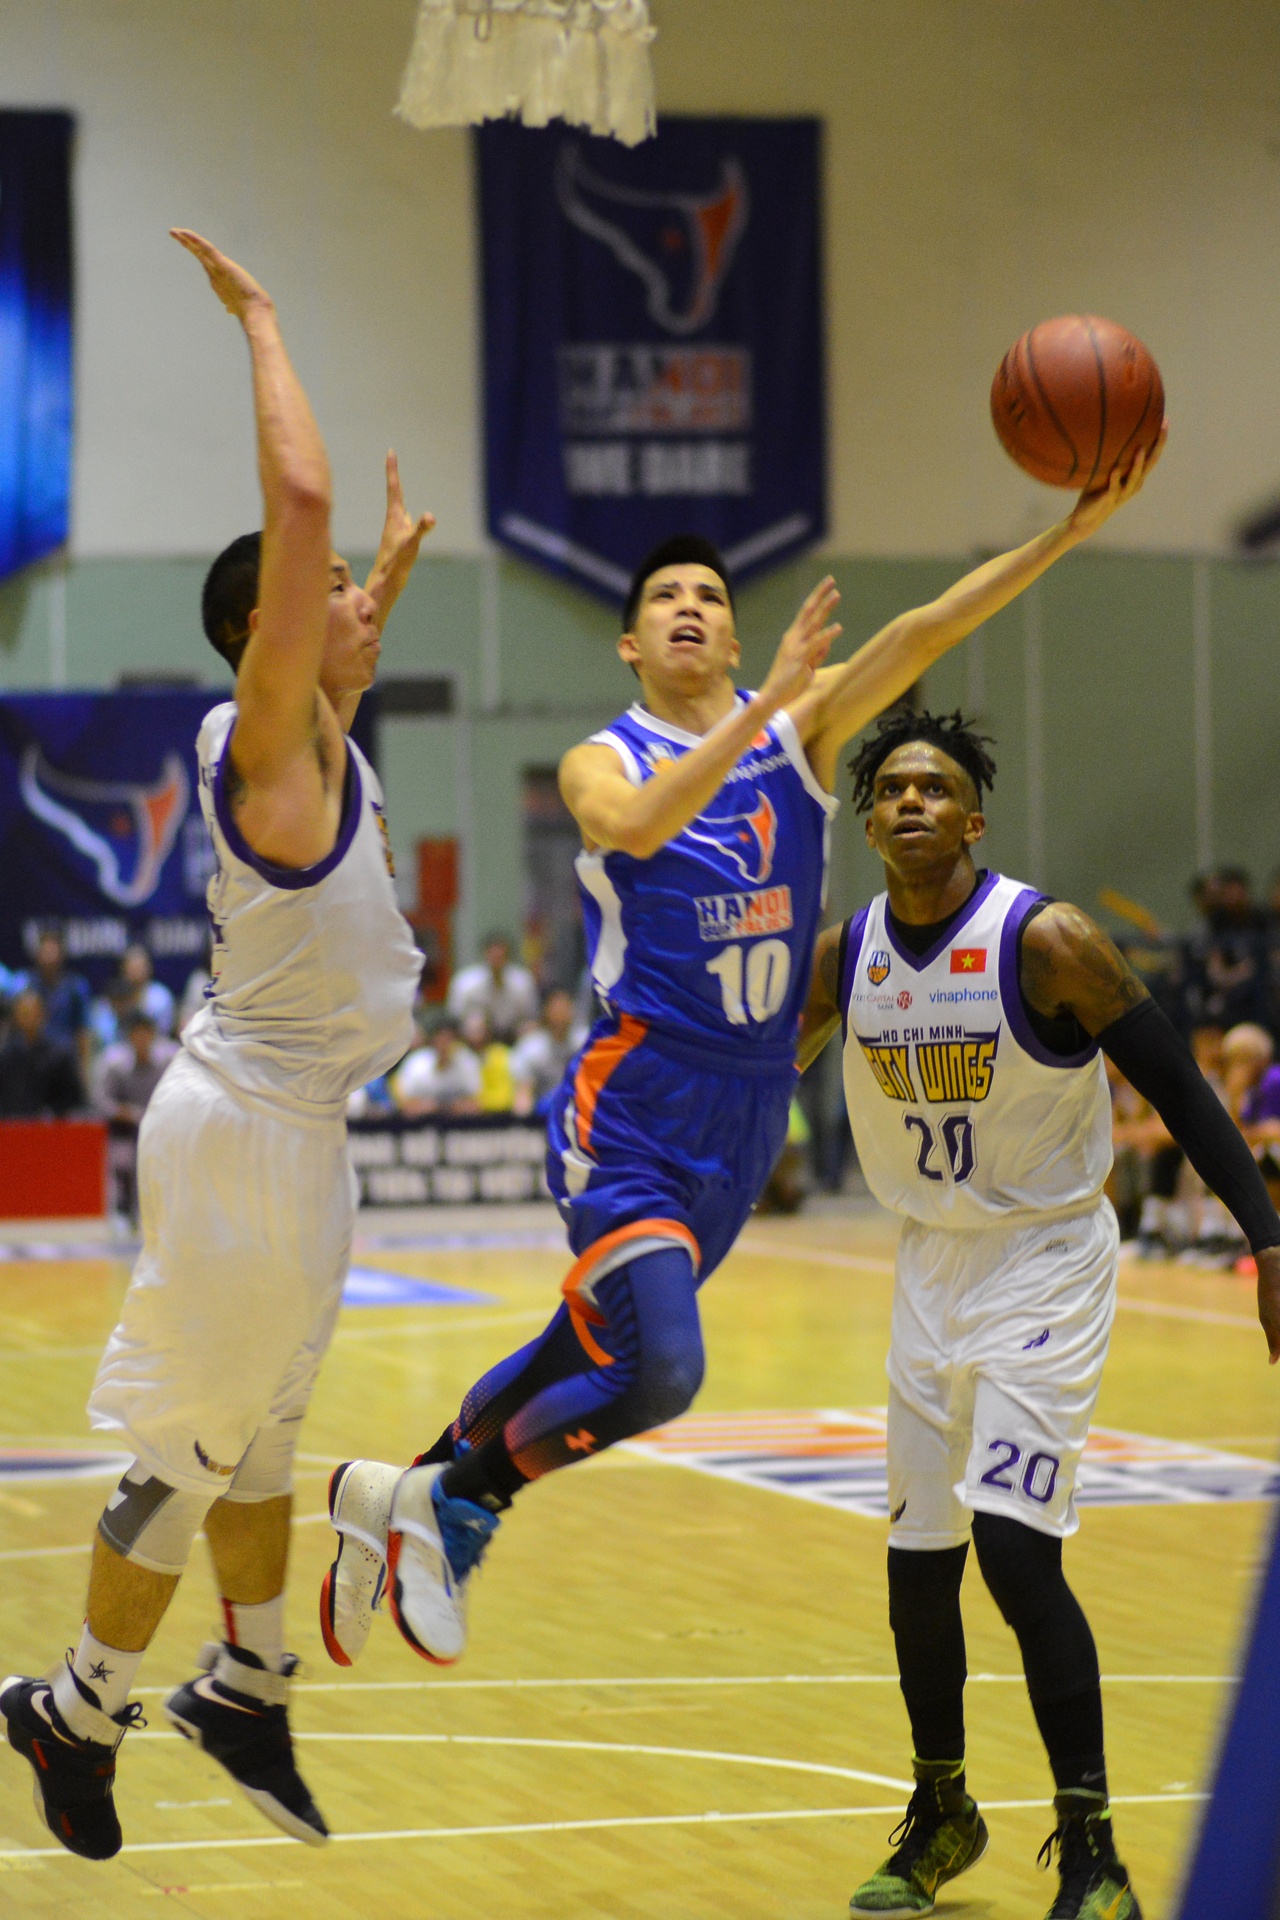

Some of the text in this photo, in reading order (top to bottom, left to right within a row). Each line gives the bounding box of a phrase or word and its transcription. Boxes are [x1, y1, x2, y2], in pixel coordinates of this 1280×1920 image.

[698, 886, 789, 922] HANOI
[705, 938, 791, 1025] 10
[929, 988, 998, 1003] vinaphone
[882, 1025, 963, 1043] HO CHI MINH
[860, 1038, 998, 1104] CITY WINGS
[901, 1110, 979, 1187] 20
[979, 1439, 1061, 1504] 20
